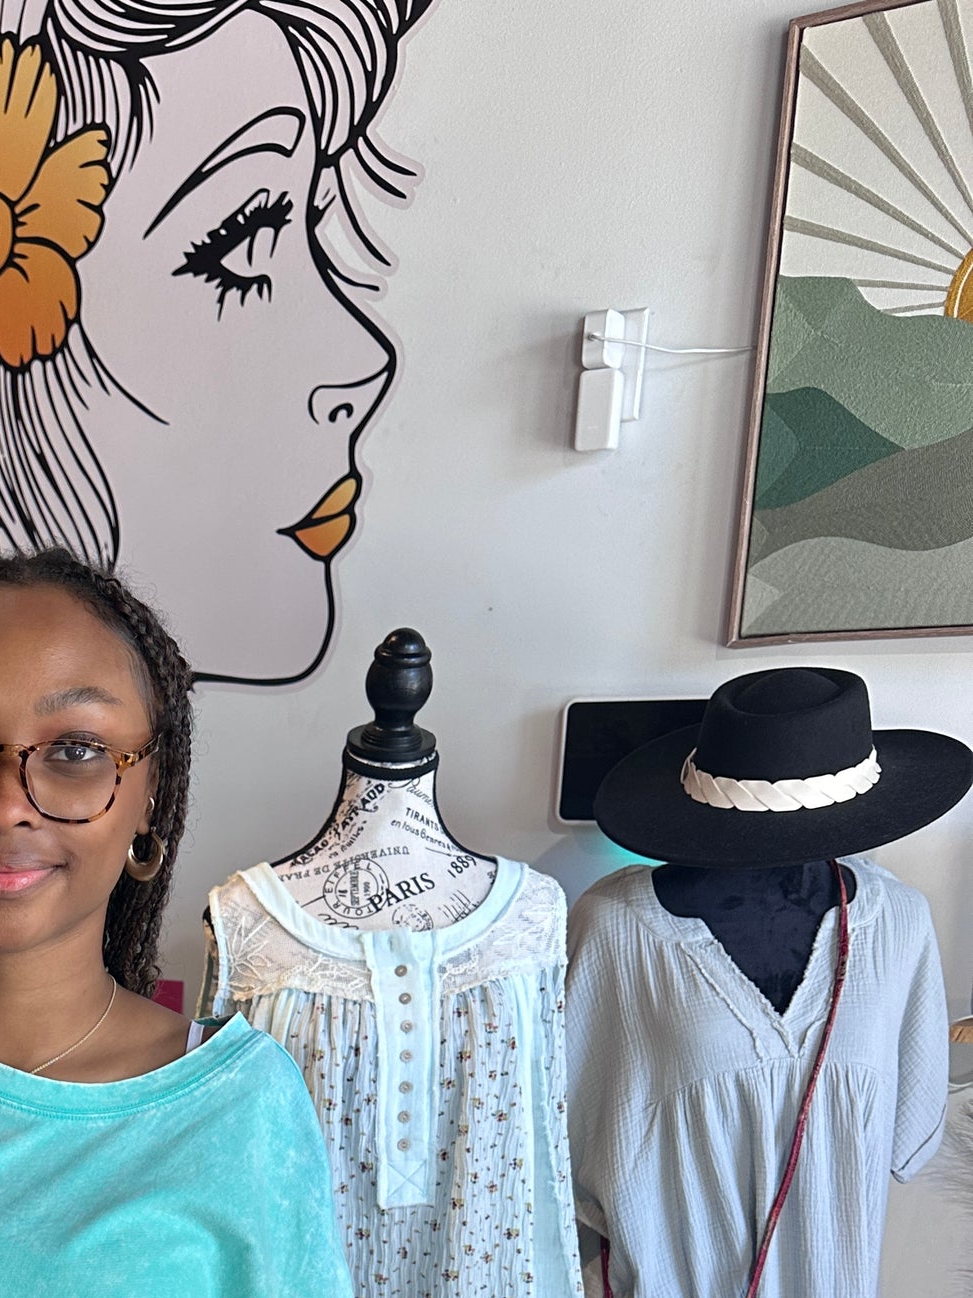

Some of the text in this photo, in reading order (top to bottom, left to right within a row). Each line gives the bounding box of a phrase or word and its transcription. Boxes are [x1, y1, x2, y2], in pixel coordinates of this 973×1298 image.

[406, 807, 439, 831] TIRANTS
[314, 864, 331, 874] DE
[447, 855, 477, 878] 1889
[367, 873, 435, 913] PARIS
[332, 902, 375, 917] TOUR
